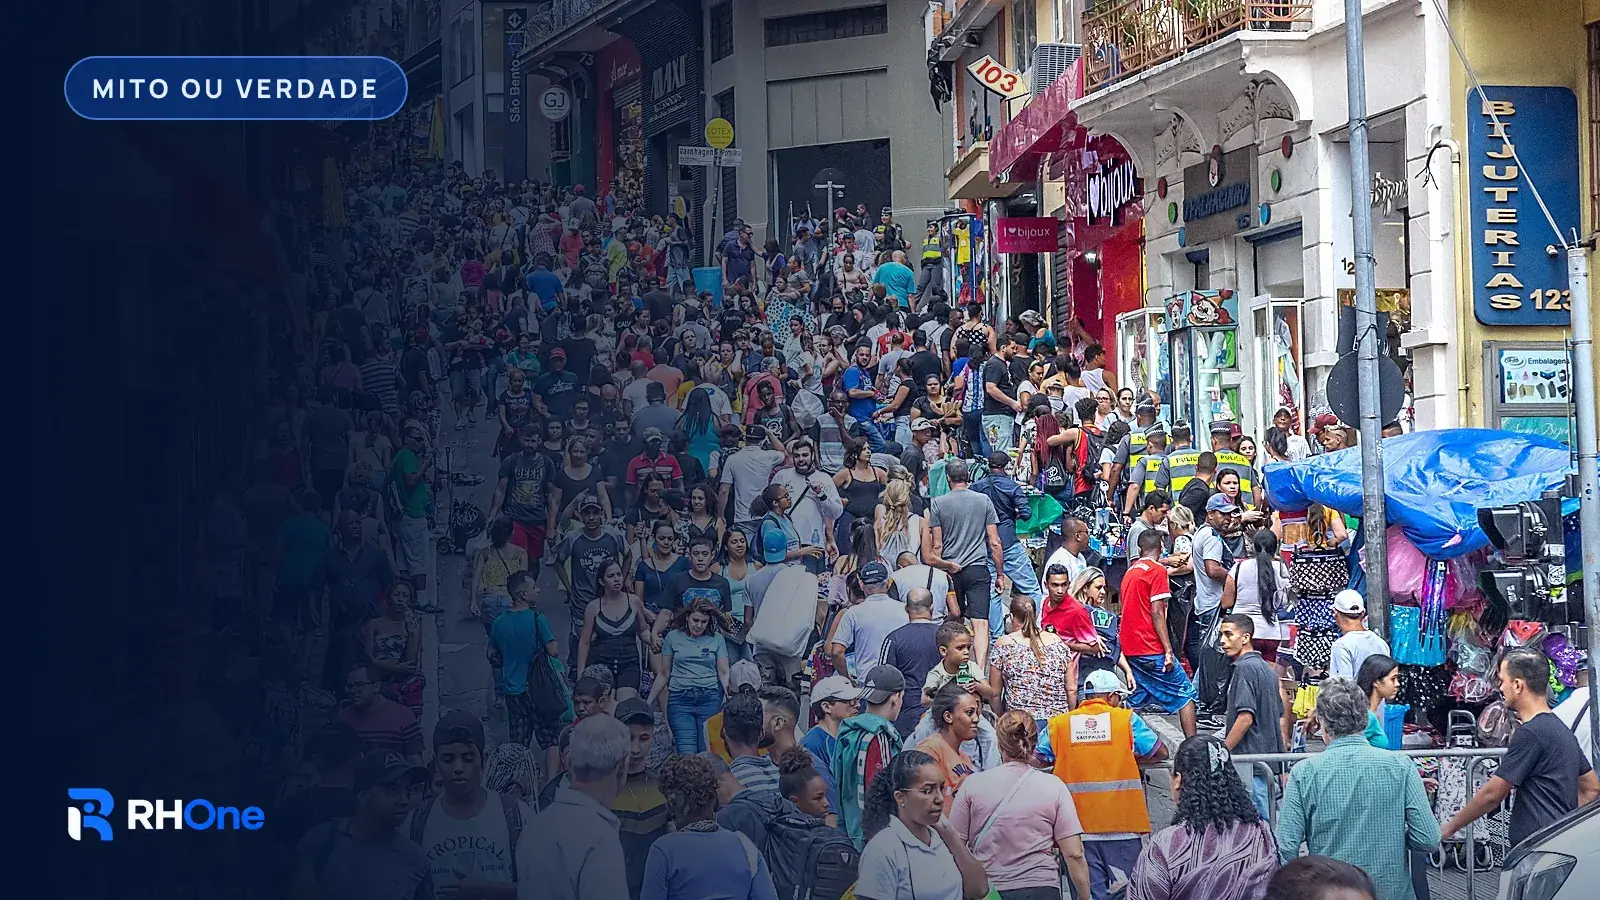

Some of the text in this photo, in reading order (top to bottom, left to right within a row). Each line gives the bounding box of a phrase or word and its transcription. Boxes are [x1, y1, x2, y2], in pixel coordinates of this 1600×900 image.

[650, 53, 688, 101] MAXI
[975, 58, 1018, 93] 103
[506, 58, 521, 123] São Bento
[544, 92, 565, 107] GJ
[707, 127, 732, 135] LOTEX
[679, 147, 714, 157] Varnhagen
[1100, 158, 1136, 227] bijoux
[1481, 100, 1524, 310] BIJUTERIAS
[1016, 226, 1051, 239] bijoux
[1340, 257, 1355, 275] 12
[1175, 455, 1200, 463] POLIC
[516, 467, 541, 478] BEER
[426, 835, 504, 861] TROPICAL
